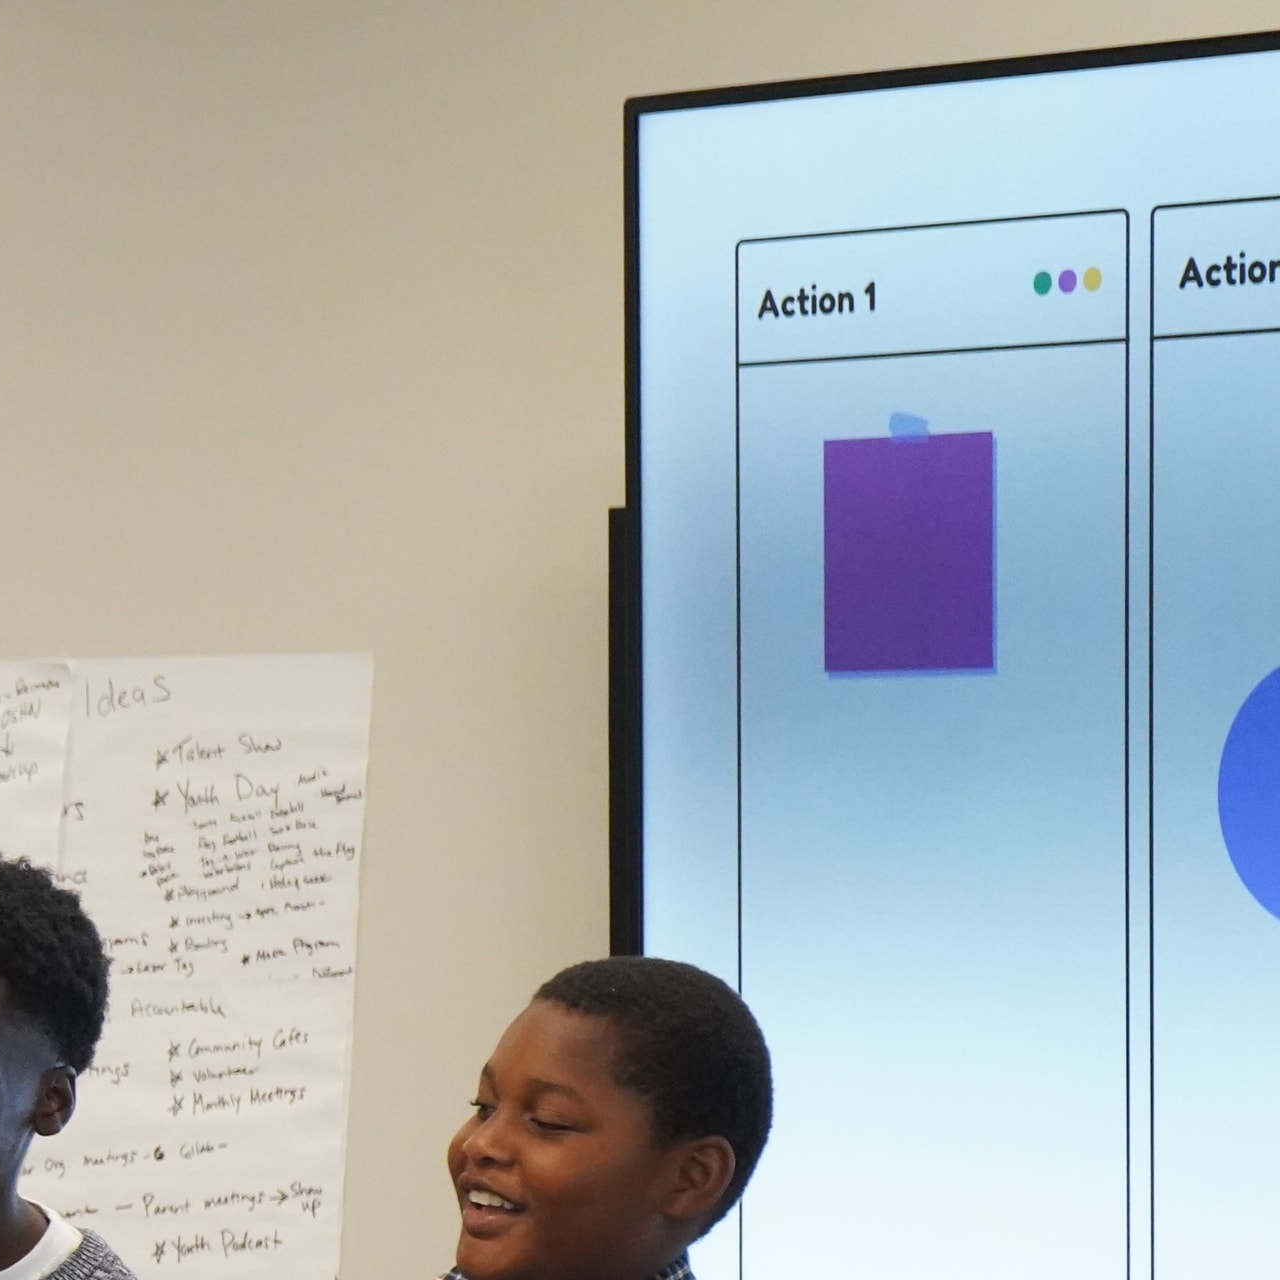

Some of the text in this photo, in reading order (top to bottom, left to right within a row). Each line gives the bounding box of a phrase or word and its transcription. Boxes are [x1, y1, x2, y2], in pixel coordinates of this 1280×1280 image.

[758, 282, 877, 319] Action 1
[233, 772, 280, 809] Day
